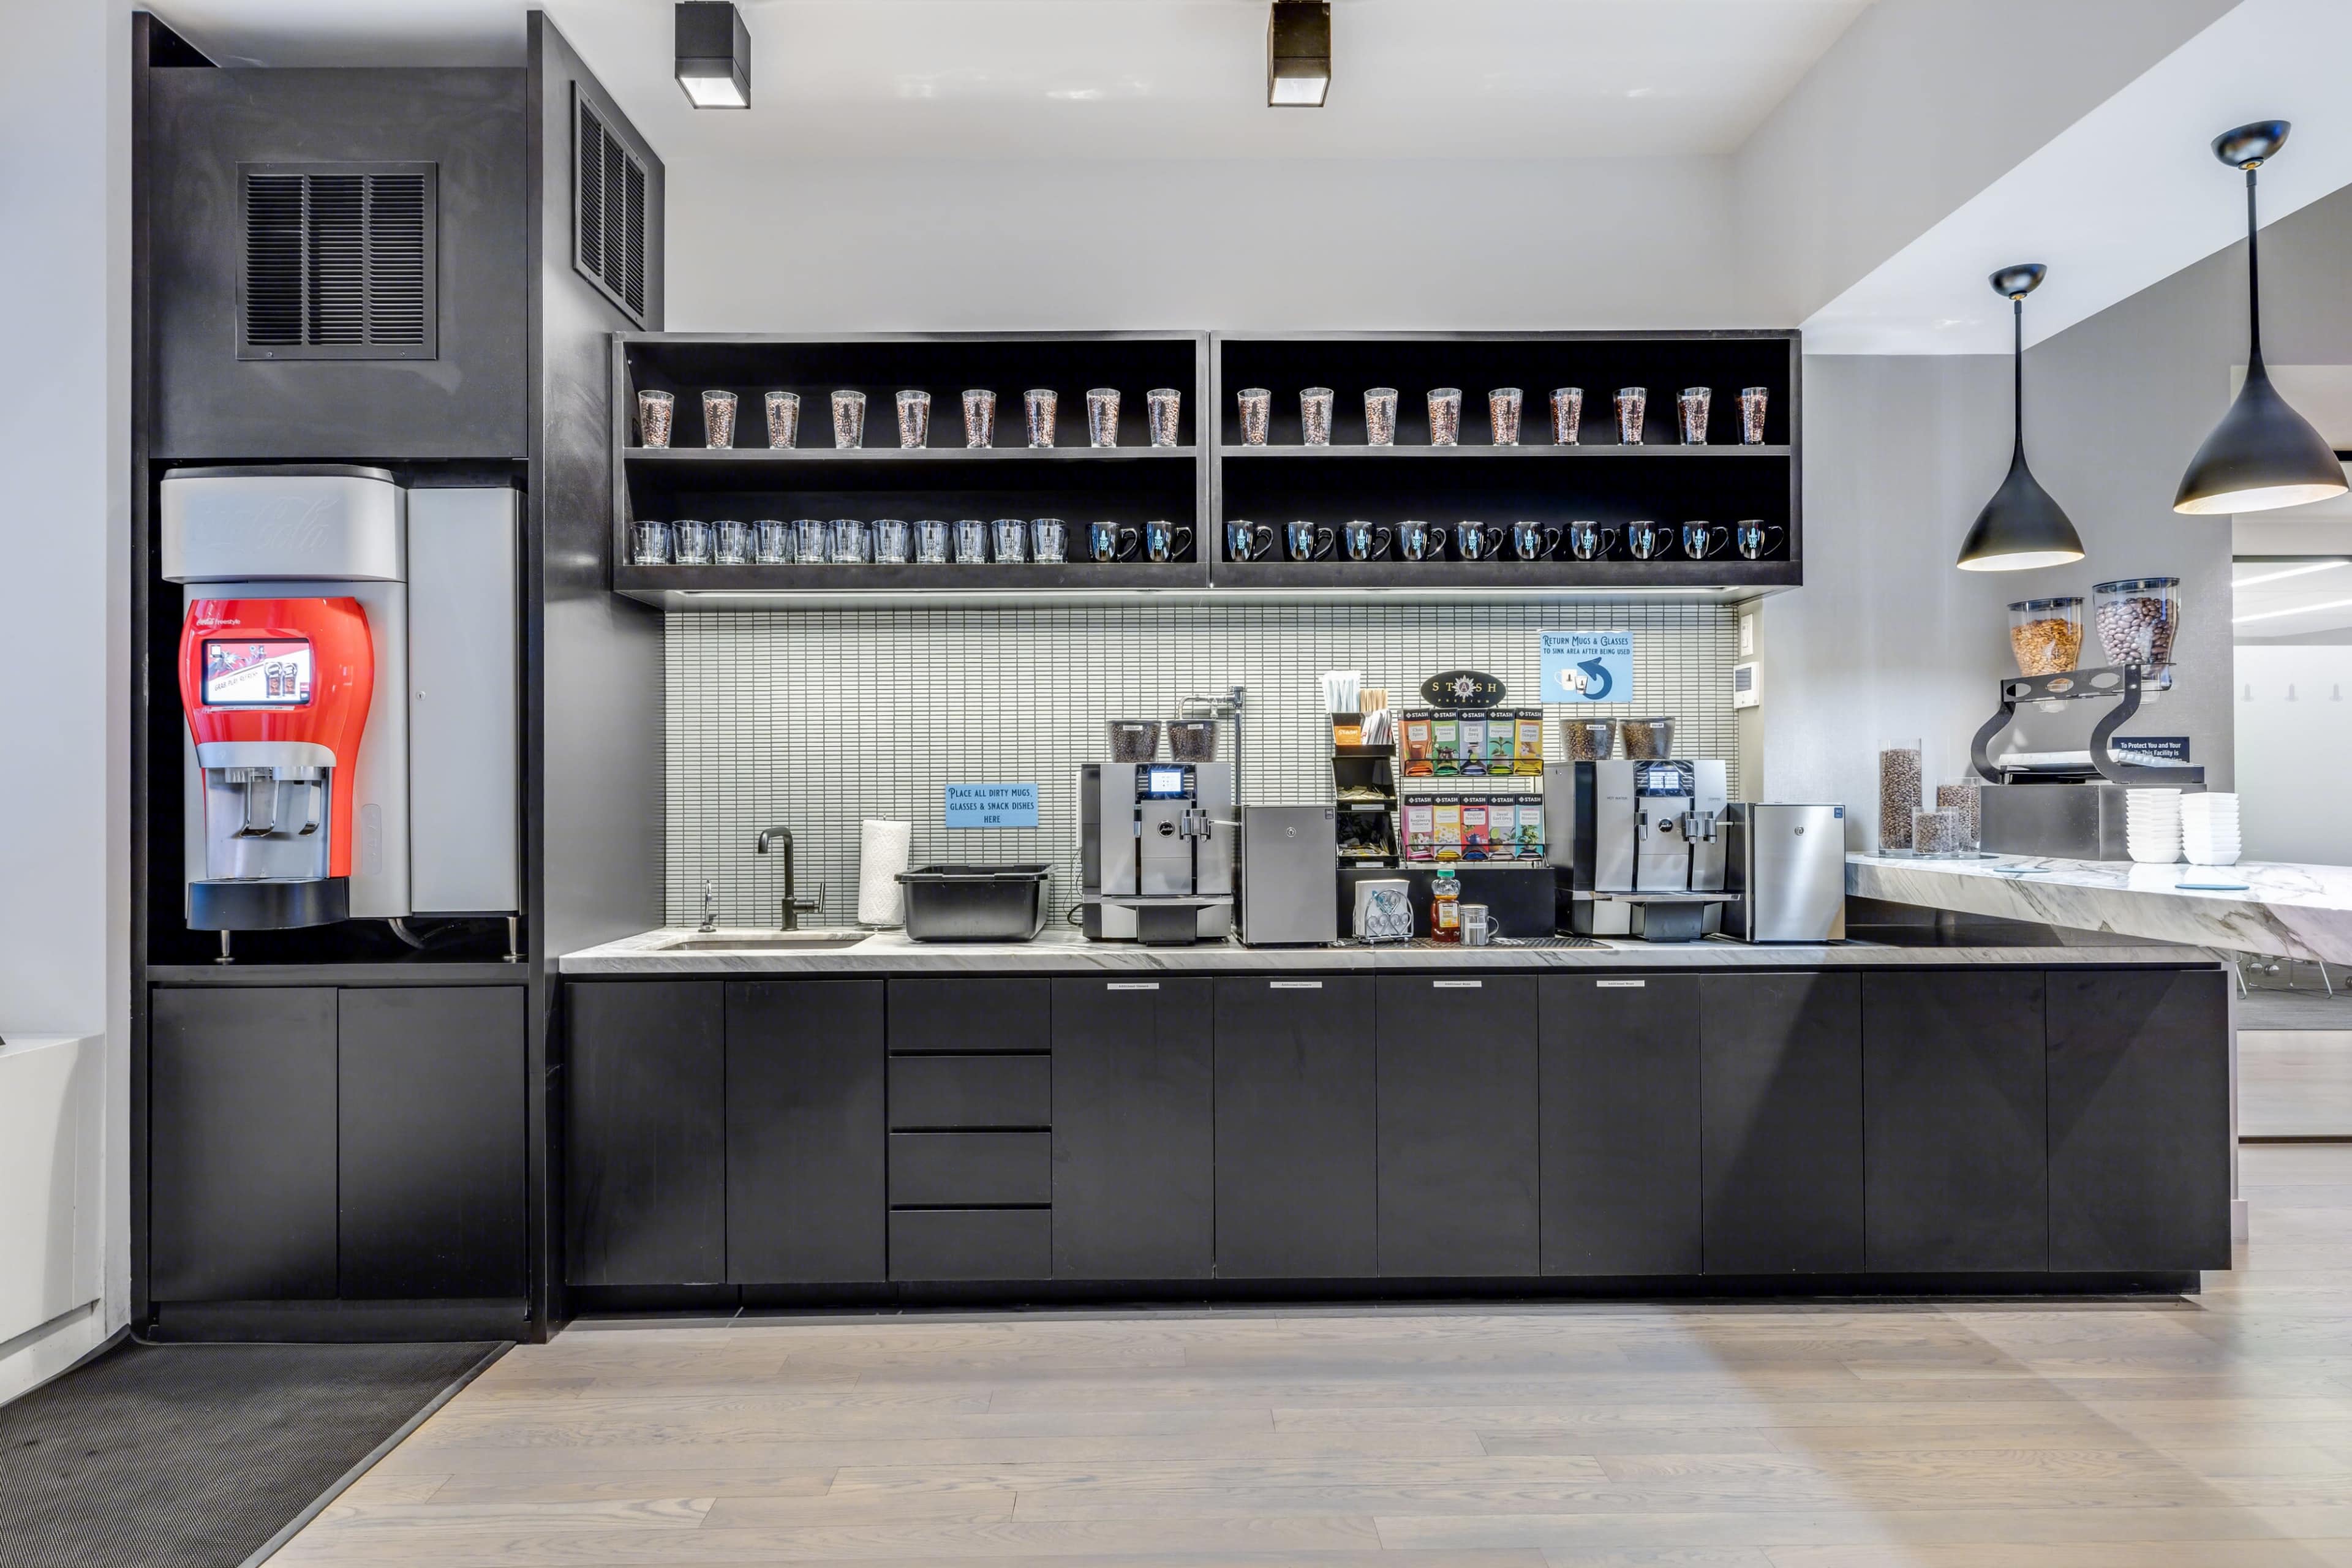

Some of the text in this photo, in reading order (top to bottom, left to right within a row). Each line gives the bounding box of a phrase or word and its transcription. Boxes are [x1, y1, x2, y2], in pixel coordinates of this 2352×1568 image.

[1543, 635, 1569, 646] RETURN
[1572, 636, 1590, 646] MUGS
[1600, 636, 1628, 646] GLASSES
[1433, 682, 1496, 692] STASH
[949, 788, 971, 799] PLACE
